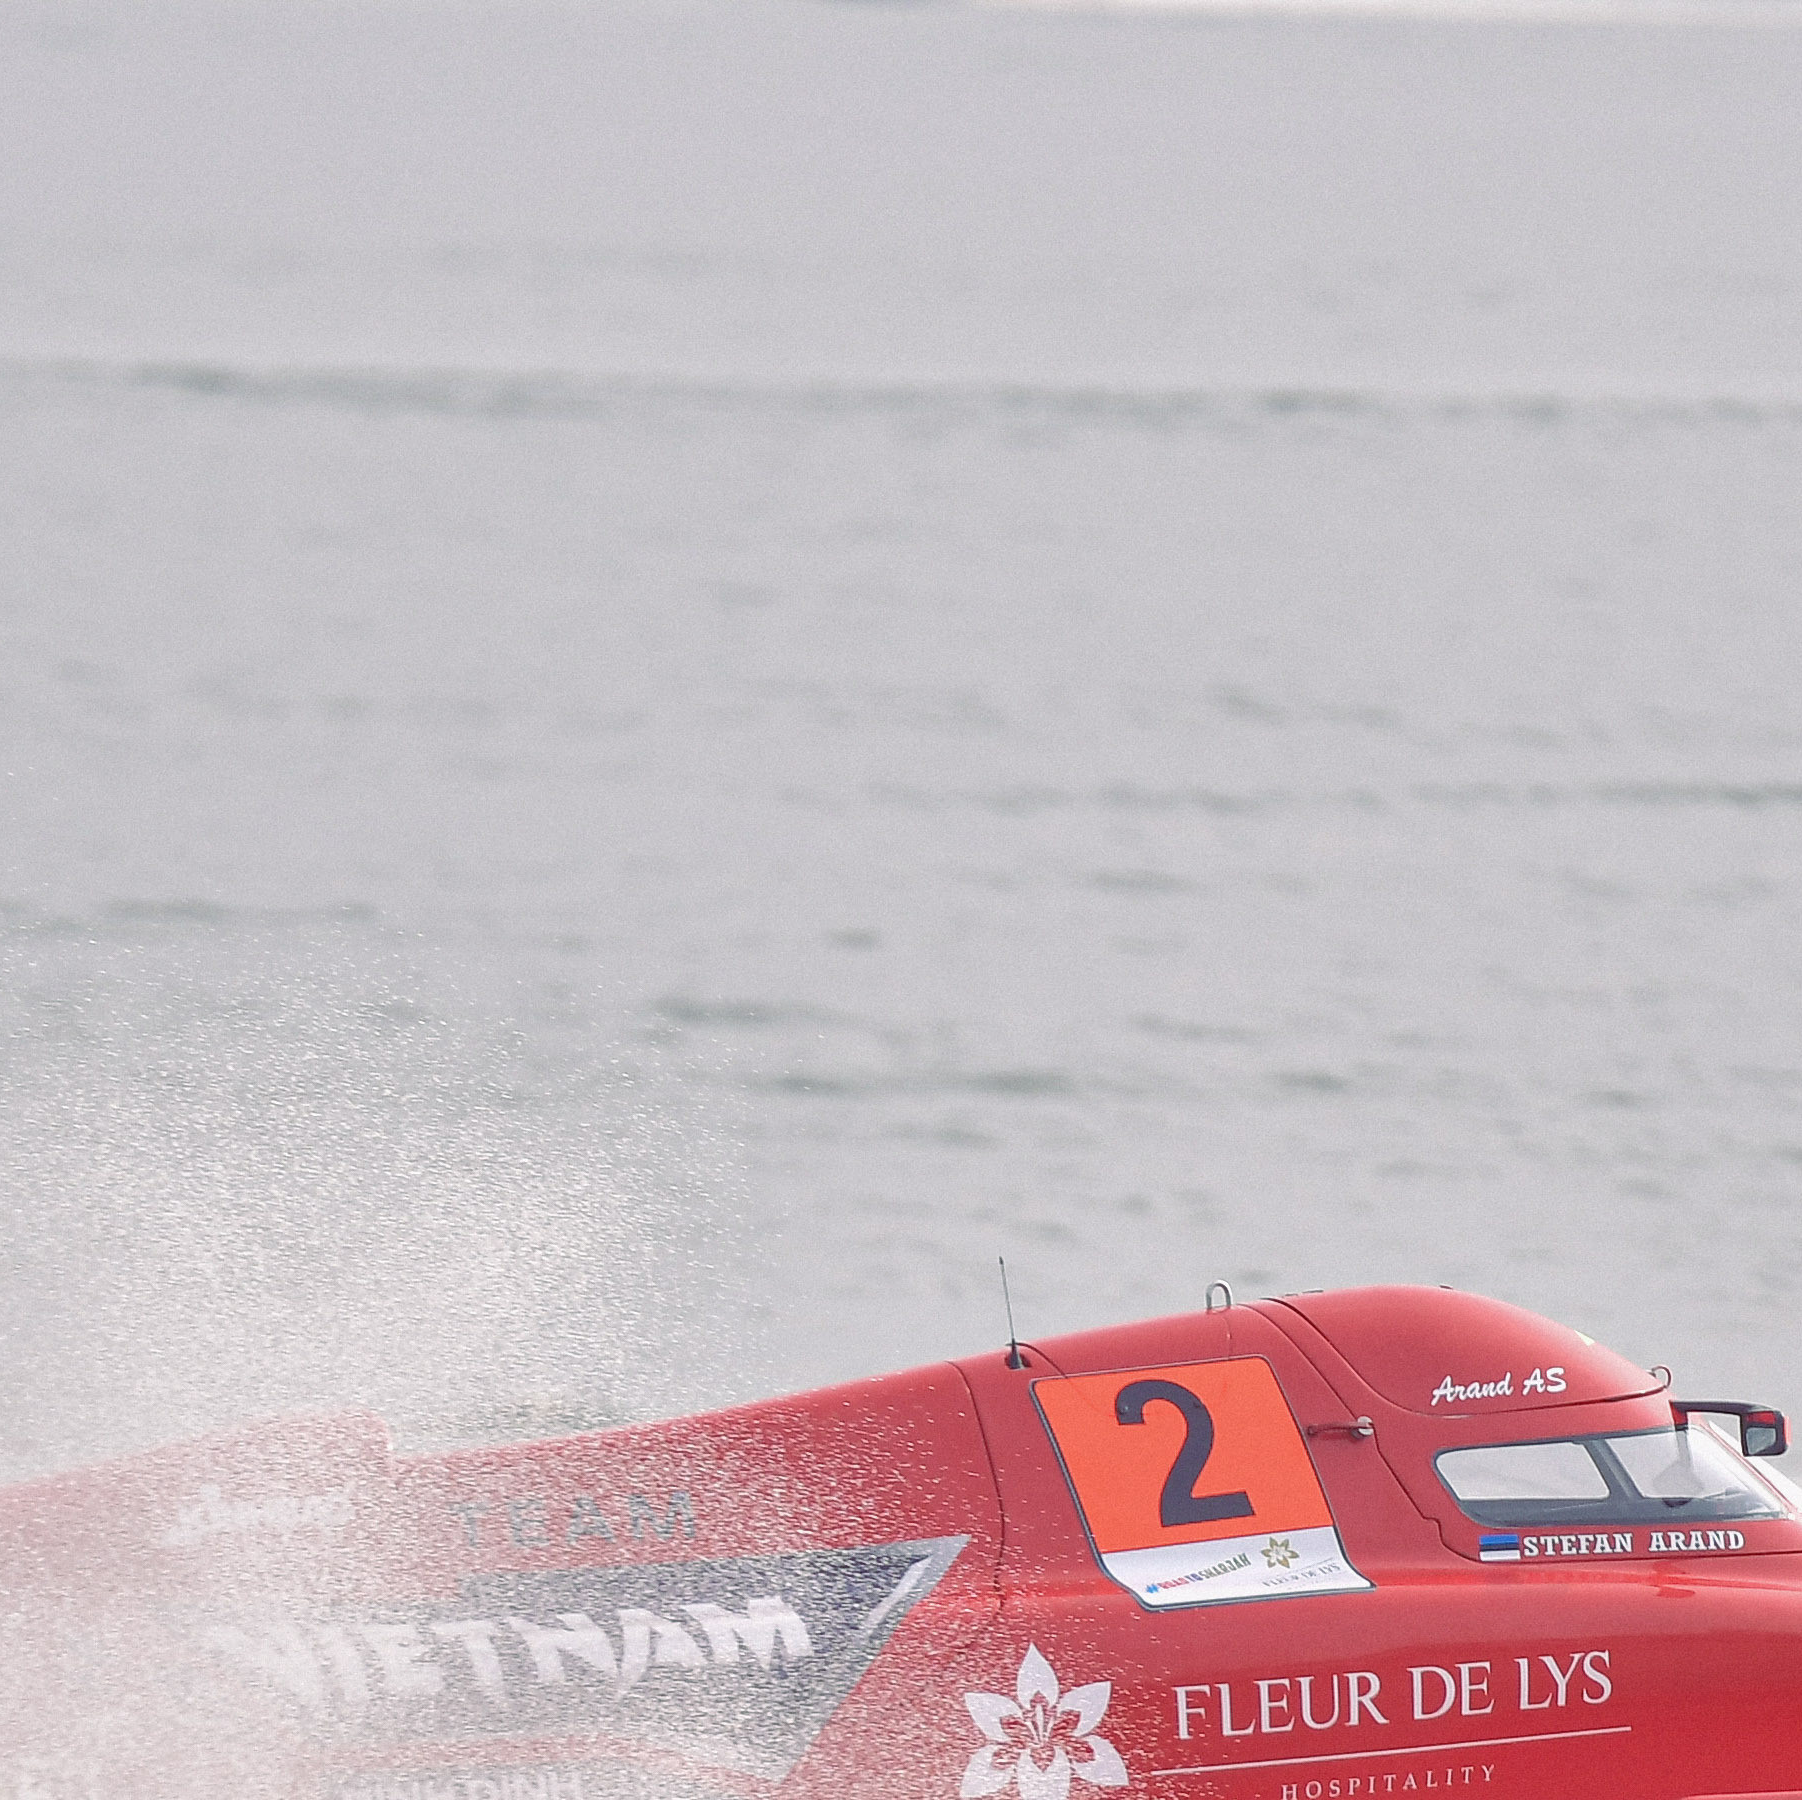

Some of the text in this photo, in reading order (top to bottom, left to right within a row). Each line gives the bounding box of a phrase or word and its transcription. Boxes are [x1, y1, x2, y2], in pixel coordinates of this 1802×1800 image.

[1431, 1367, 1567, 1406] Arand AS
[1116, 1379, 1257, 1527] 2
[449, 1490, 696, 1549] TEAM
[1523, 1530, 1745, 1556] STEFAN ARAND
[1173, 1649, 1613, 1740] FLEUR DE LYS
[1281, 1764, 1496, 1800] HOSPITALITY
